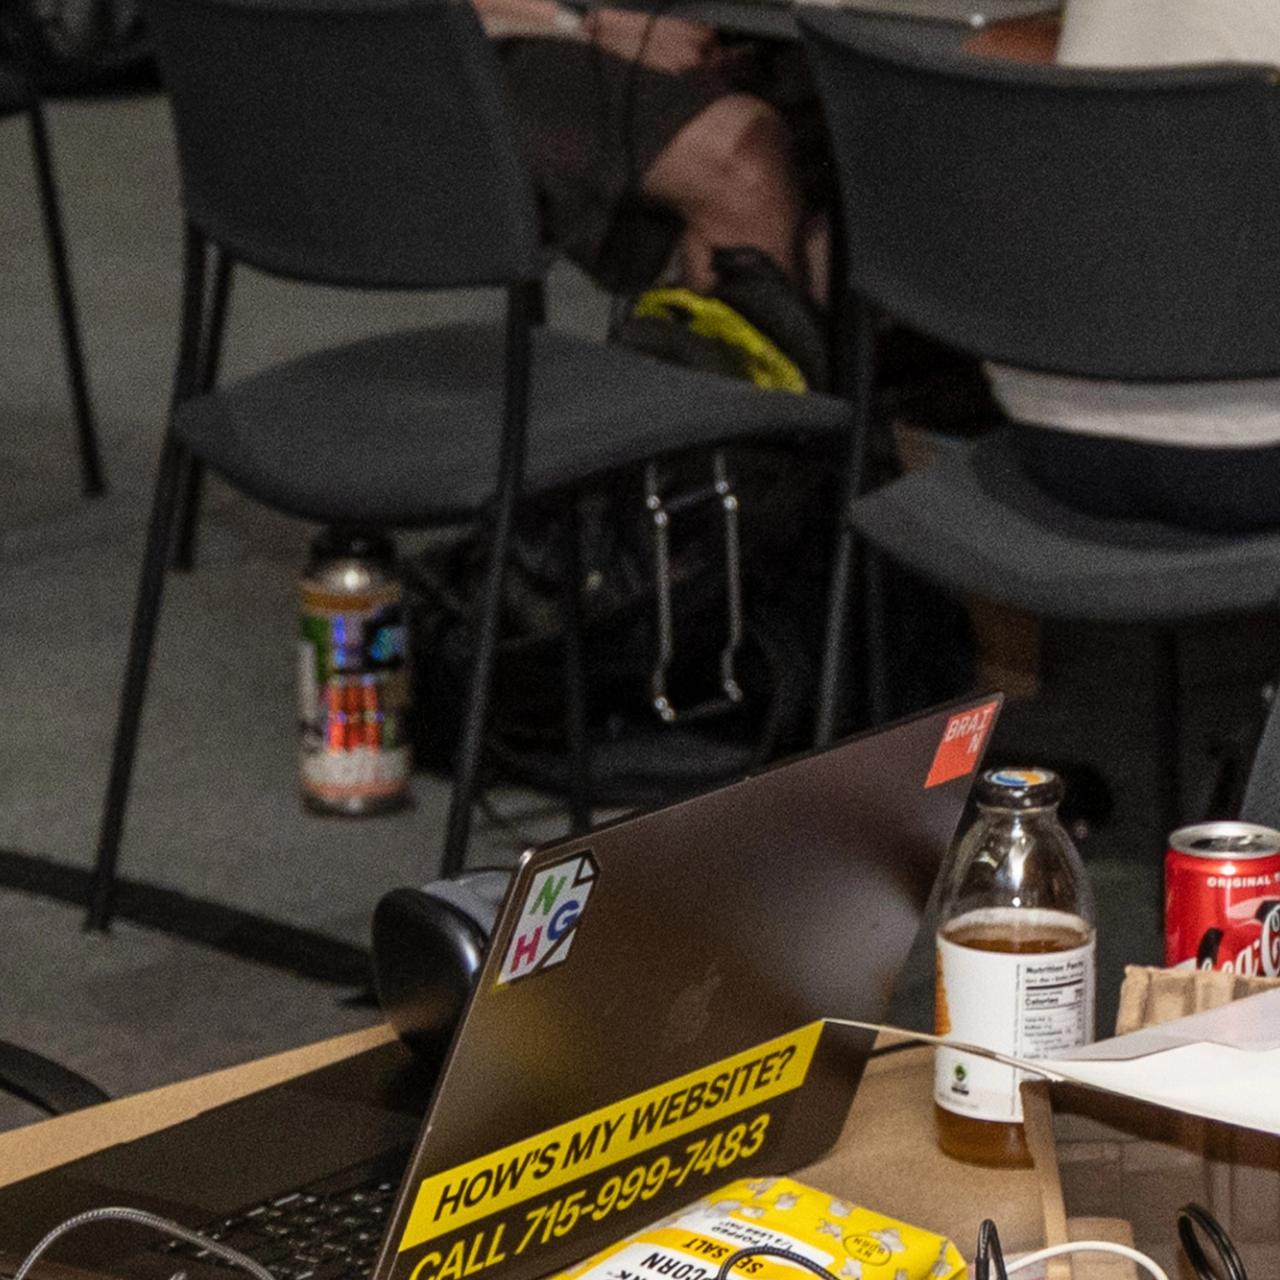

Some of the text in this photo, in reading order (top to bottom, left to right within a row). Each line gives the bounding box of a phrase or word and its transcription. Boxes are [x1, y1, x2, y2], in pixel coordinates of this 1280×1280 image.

[529, 874, 567, 915] N
[1207, 875, 1271, 888] ORIGINAL
[546, 899, 580, 941] G
[510, 925, 543, 973] H
[434, 1044, 797, 1222] HOW'S MY WEBSITE?
[515, 1112, 772, 1256] 715-999-7483
[680, 1238, 730, 1259] SALT
